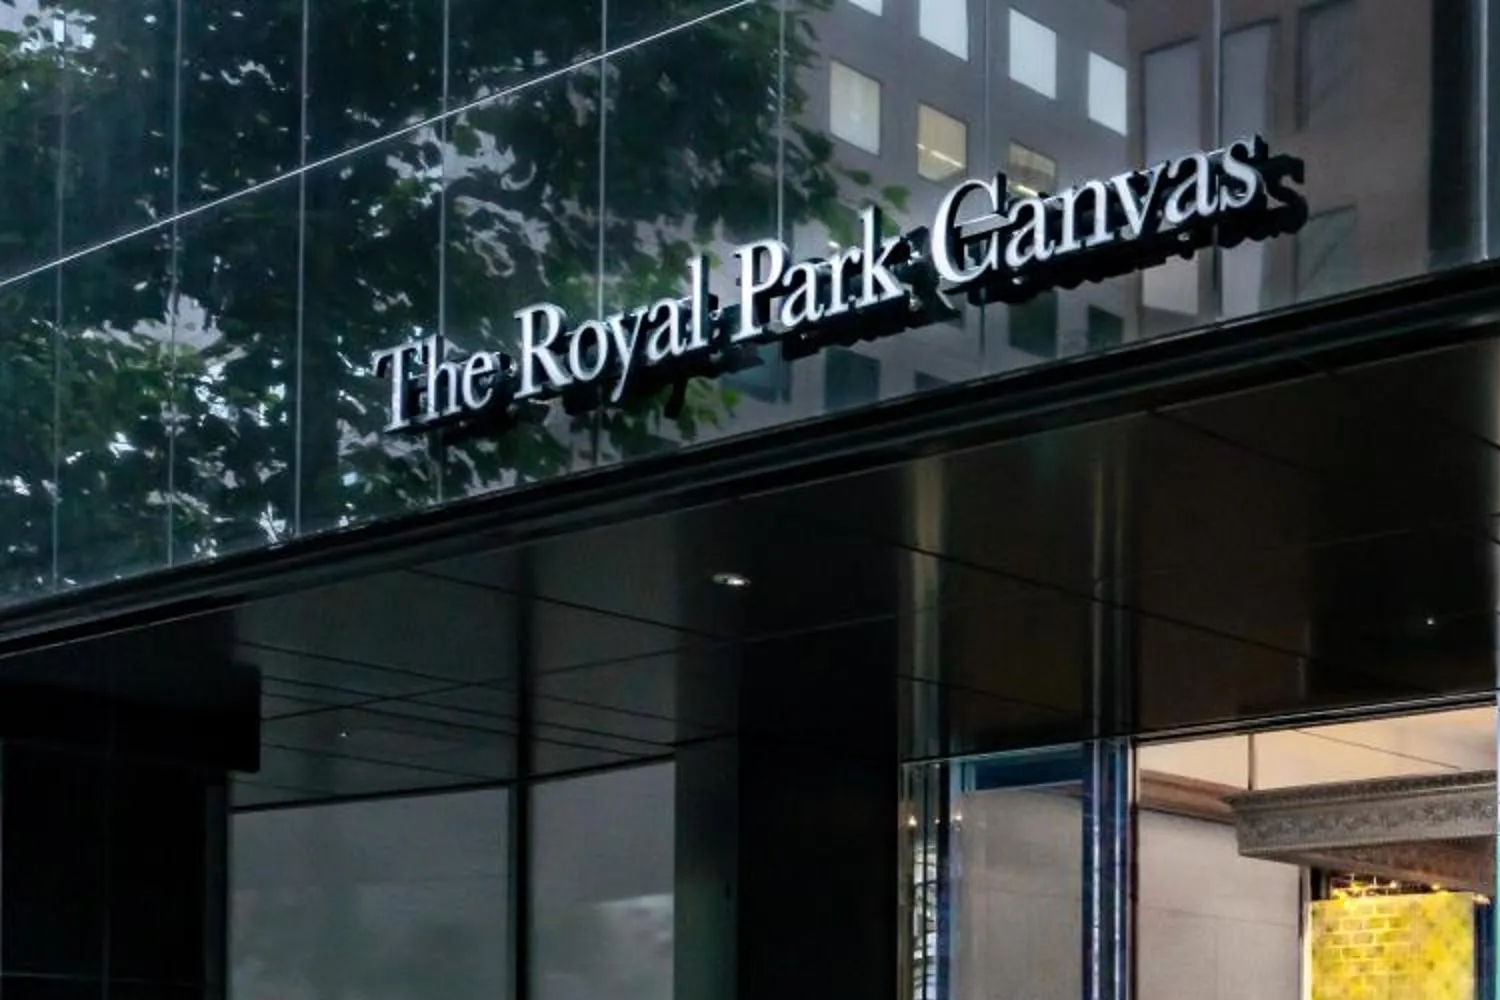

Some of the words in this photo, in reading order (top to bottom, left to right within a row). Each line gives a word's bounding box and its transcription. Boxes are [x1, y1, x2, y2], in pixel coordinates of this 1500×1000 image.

[372, 333, 494, 433] The
[513, 255, 711, 402] Royal
[730, 205, 908, 342] Park
[930, 136, 1262, 284] Canvas
